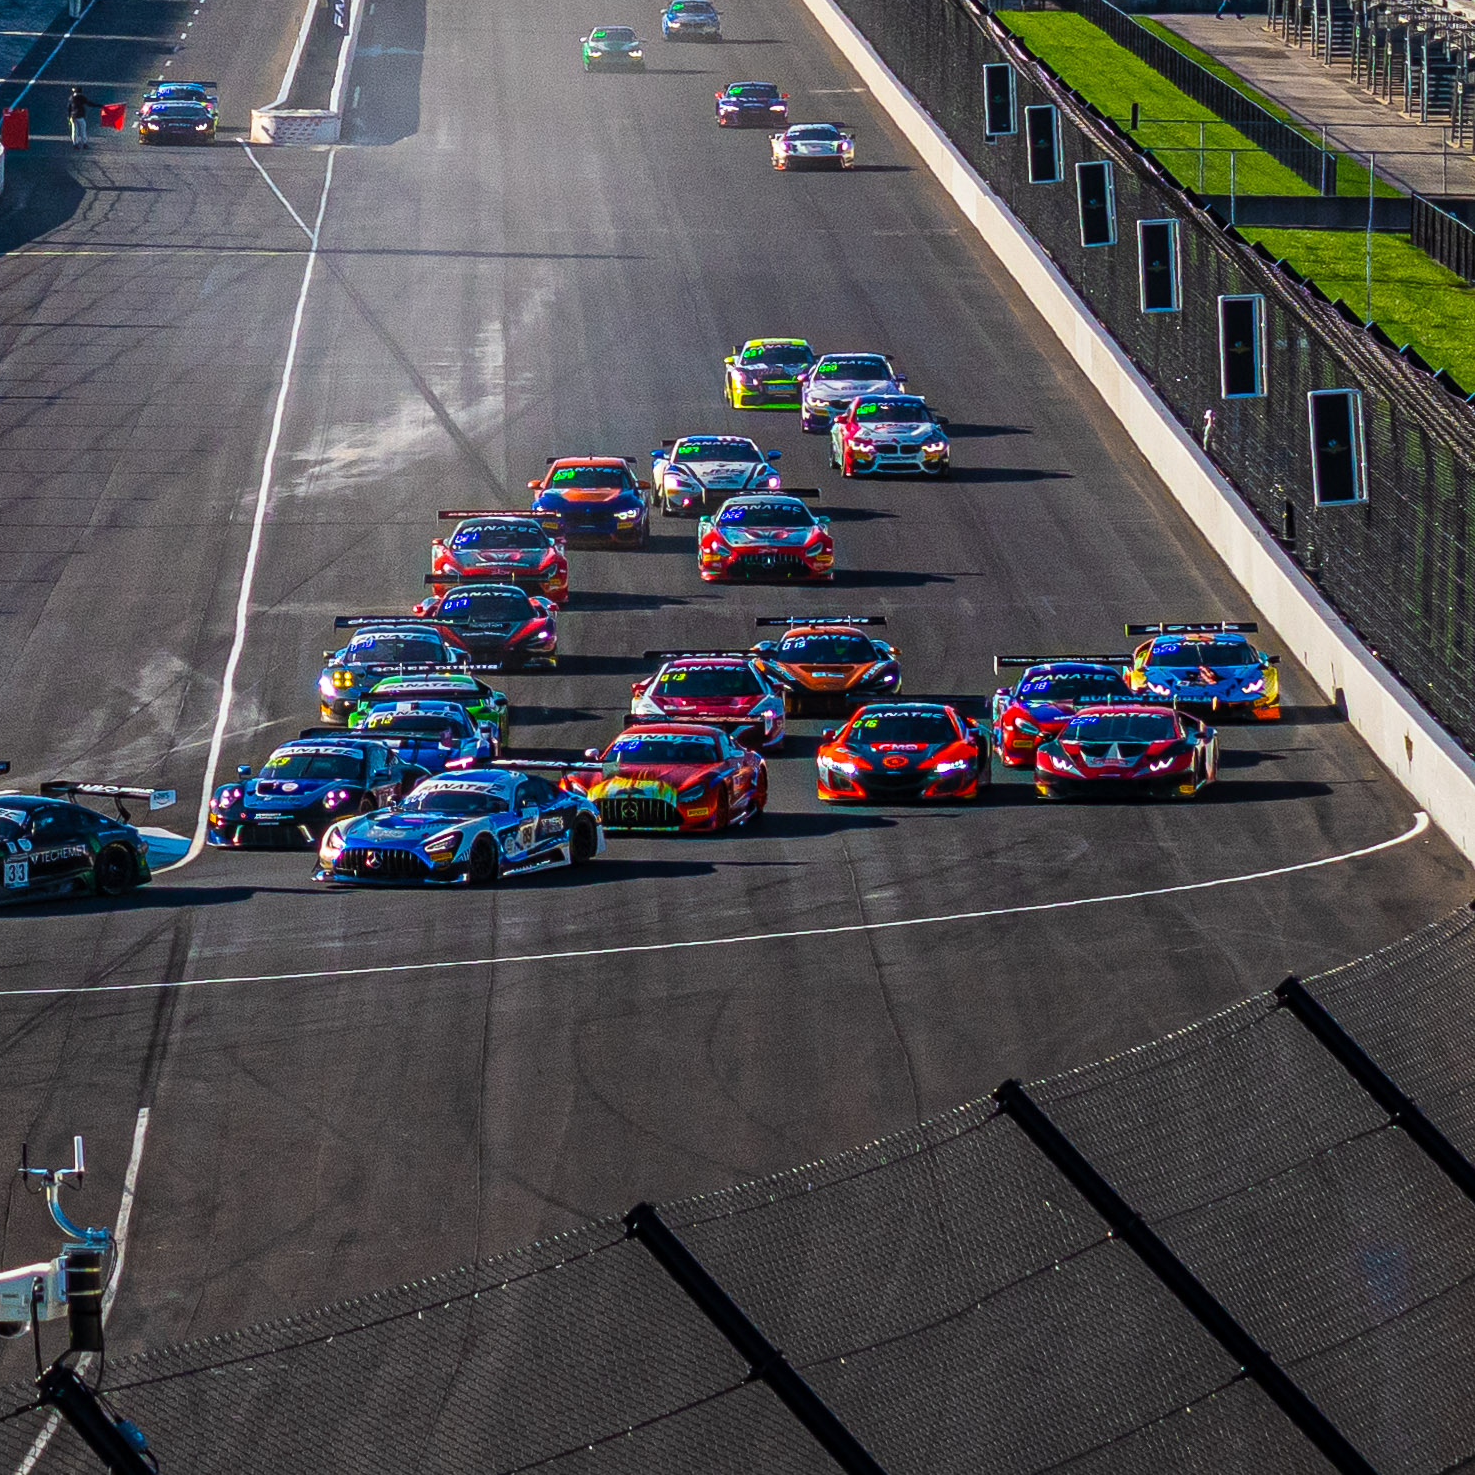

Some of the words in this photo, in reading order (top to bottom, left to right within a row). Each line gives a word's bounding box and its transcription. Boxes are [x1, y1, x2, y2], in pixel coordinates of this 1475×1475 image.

[729, 504, 802, 512] FANATEC
[462, 525, 539, 534] FANATEC
[449, 592, 522, 600] FANATEC
[784, 634, 860, 642] FANATEC
[667, 665, 747, 673] FANATEC
[1030, 673, 1117, 683] FANATEC
[383, 682, 463, 690] FANATEC
[861, 712, 945, 720] FANATEC
[276, 747, 359, 756] FANATEC
[418, 781, 499, 795] FANATEC
[8, 863, 26, 881] 33
